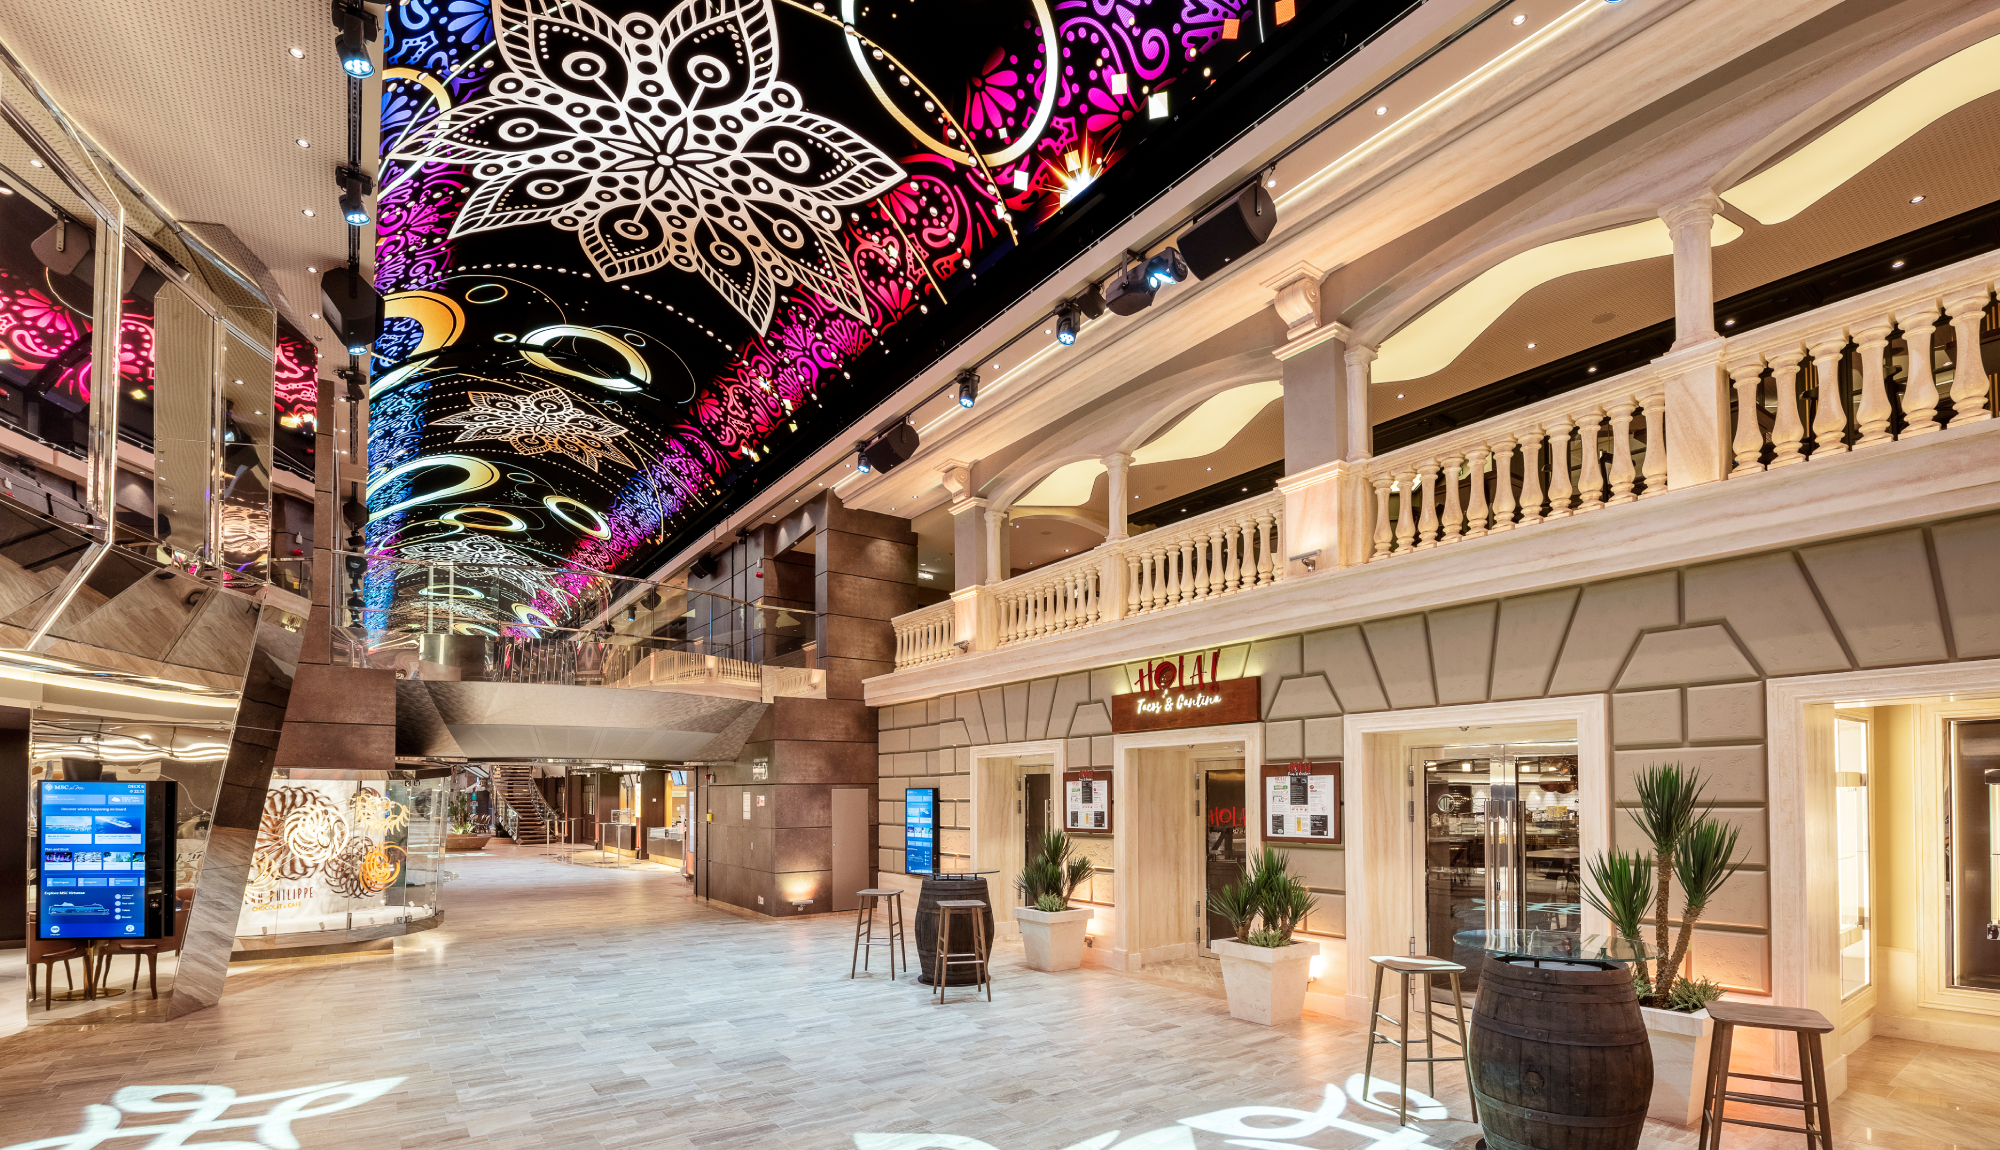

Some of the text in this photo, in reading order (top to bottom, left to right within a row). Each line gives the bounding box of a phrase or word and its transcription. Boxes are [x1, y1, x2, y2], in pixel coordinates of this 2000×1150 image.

[1134, 649, 1221, 698] HOLA!
[1137, 693, 1221, 714] Tacos & Cantina
[270, 887, 313, 902] PHILIPPE
[252, 903, 282, 912] CHOCOLAT
